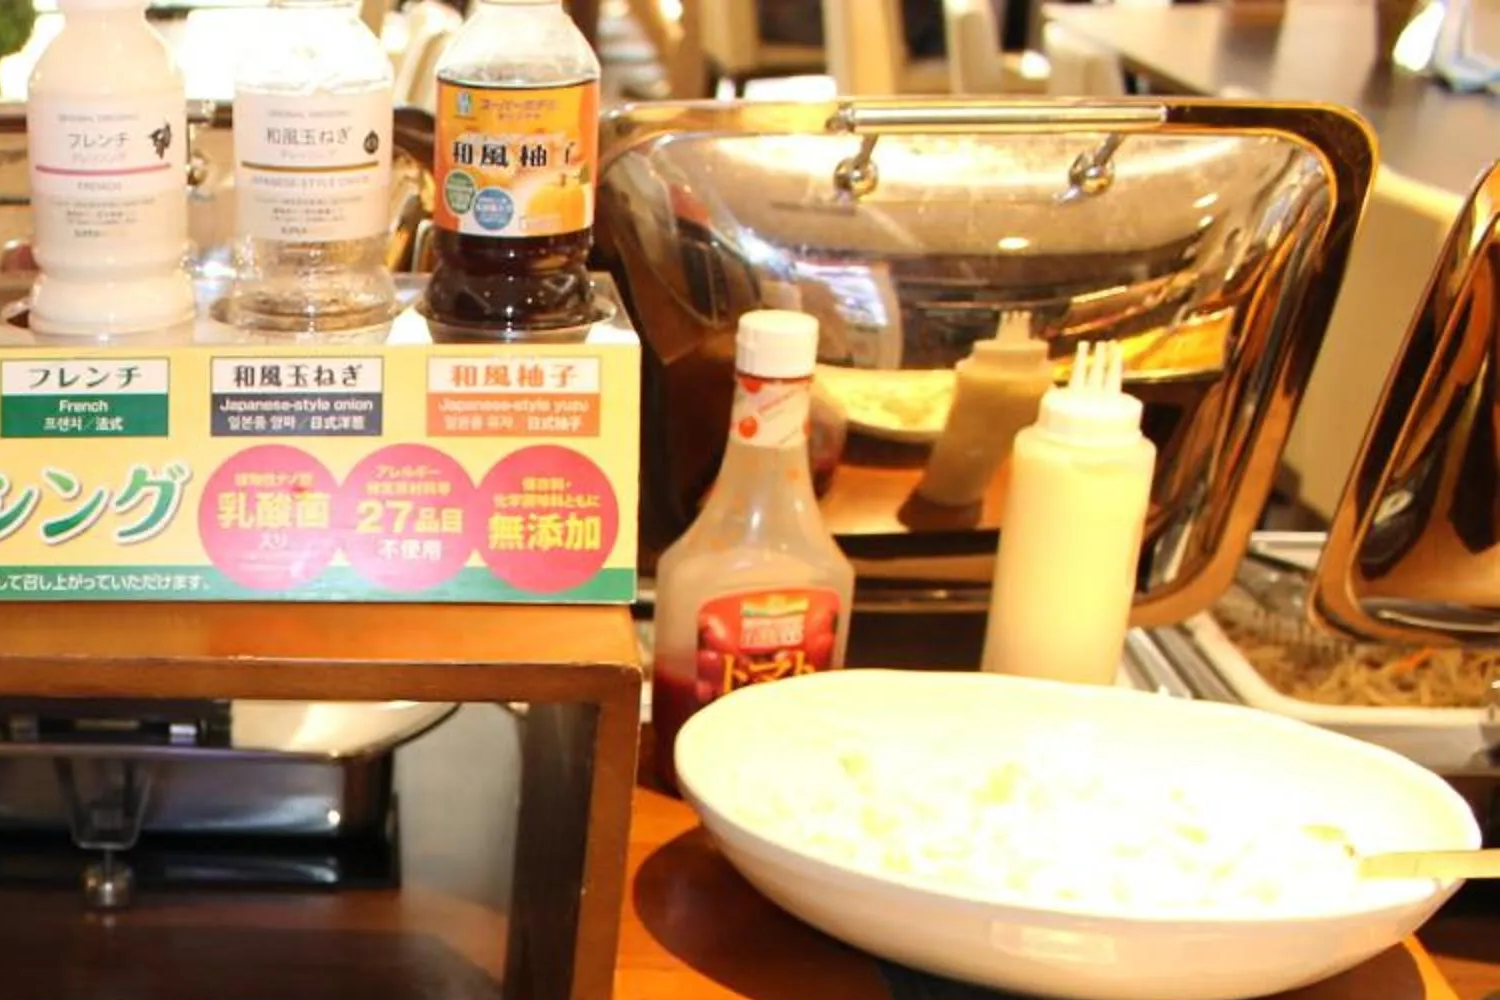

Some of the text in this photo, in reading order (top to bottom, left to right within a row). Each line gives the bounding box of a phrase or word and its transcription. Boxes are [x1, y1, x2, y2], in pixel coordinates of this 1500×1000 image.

[67, 133, 129, 149] フレンチ
[266, 126, 353, 146] 和風玉ねぎ
[28, 365, 143, 390] フレンチ
[234, 363, 363, 388] 和風玉ねぎ
[452, 364, 577, 388] 和風柚子
[59, 399, 109, 413] French
[219, 398, 373, 413] Japanese-style onion
[438, 398, 551, 413] Japanese-style
[373, 464, 442, 479] アレルギー
[216, 491, 330, 529] 乳酸菌
[355, 499, 464, 534] 27品目
[487, 511, 601, 552] 無添加
[377, 538, 442, 561] 不使用
